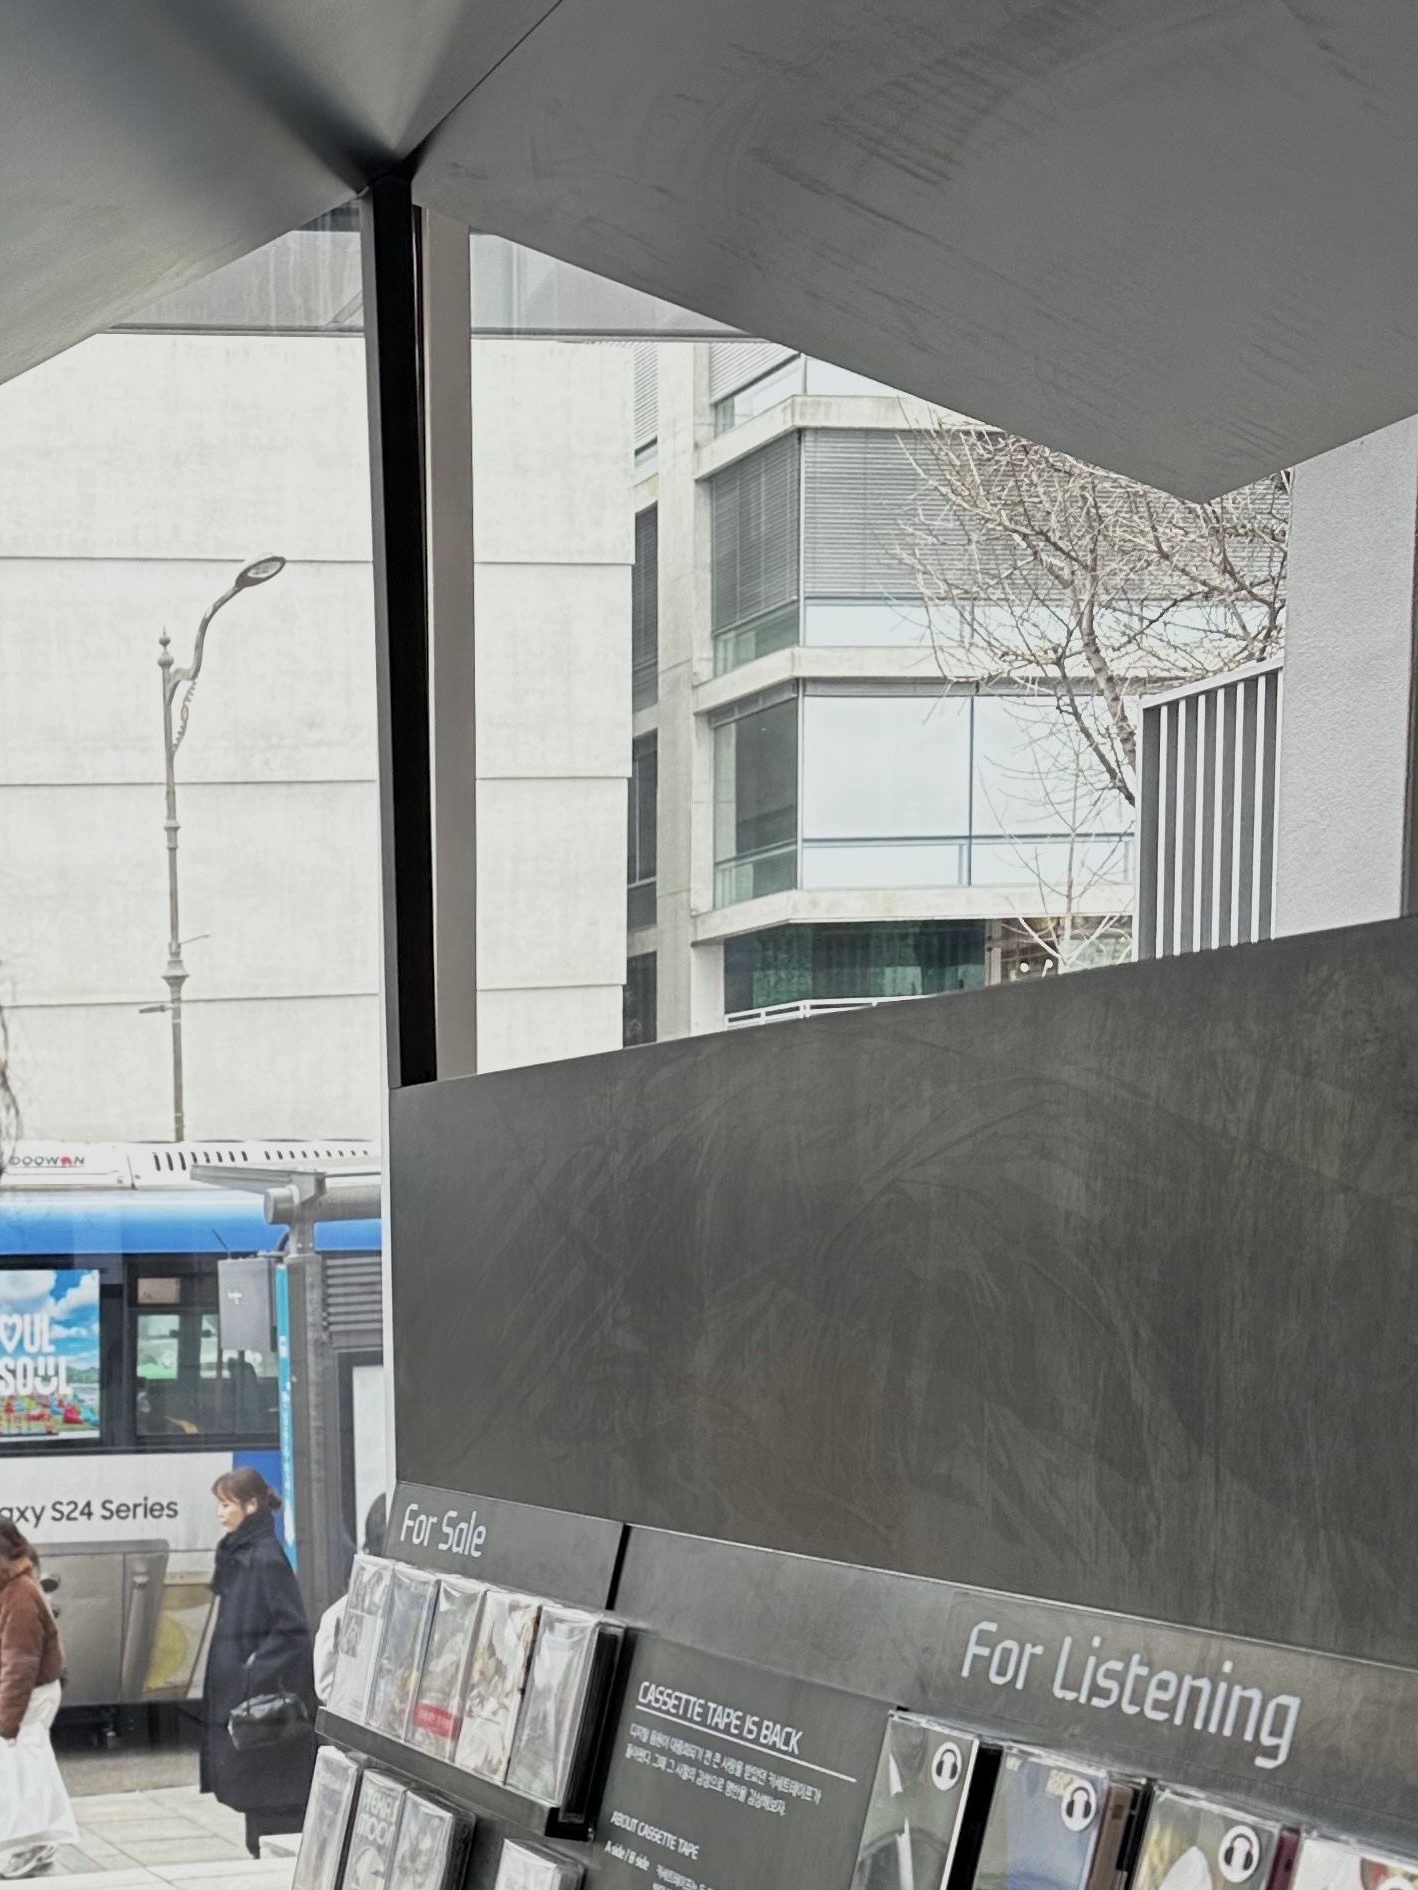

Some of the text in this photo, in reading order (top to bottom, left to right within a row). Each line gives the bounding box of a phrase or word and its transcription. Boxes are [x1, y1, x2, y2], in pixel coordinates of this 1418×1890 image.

[51, 1500, 93, 1522] S24
[101, 1496, 178, 1520] Series
[400, 1503, 486, 1557] For Sale
[638, 1680, 802, 1754] CASSETTE TAPE IS BACK
[961, 1621, 1300, 1769] For Listening
[629, 1723, 649, 1742] 디지털
[649, 1730, 668, 1750] 음원이
[669, 1737, 703, 1762] 대중화되기
[703, 1749, 711, 1765] 전
[720, 1755, 742, 1776] 사랑을
[766, 1771, 821, 1805] 카세트테이프가
[666, 1758, 675, 1775] 그
[695, 1769, 724, 1794] 감성으로
[605, 1839, 611, 1853] A
[611, 1842, 625, 1859] side
[628, 1850, 635, 1864] B
[635, 1852, 650, 1871] side
[611, 1810, 699, 1860] ABOUT CASSETTE TAPE
